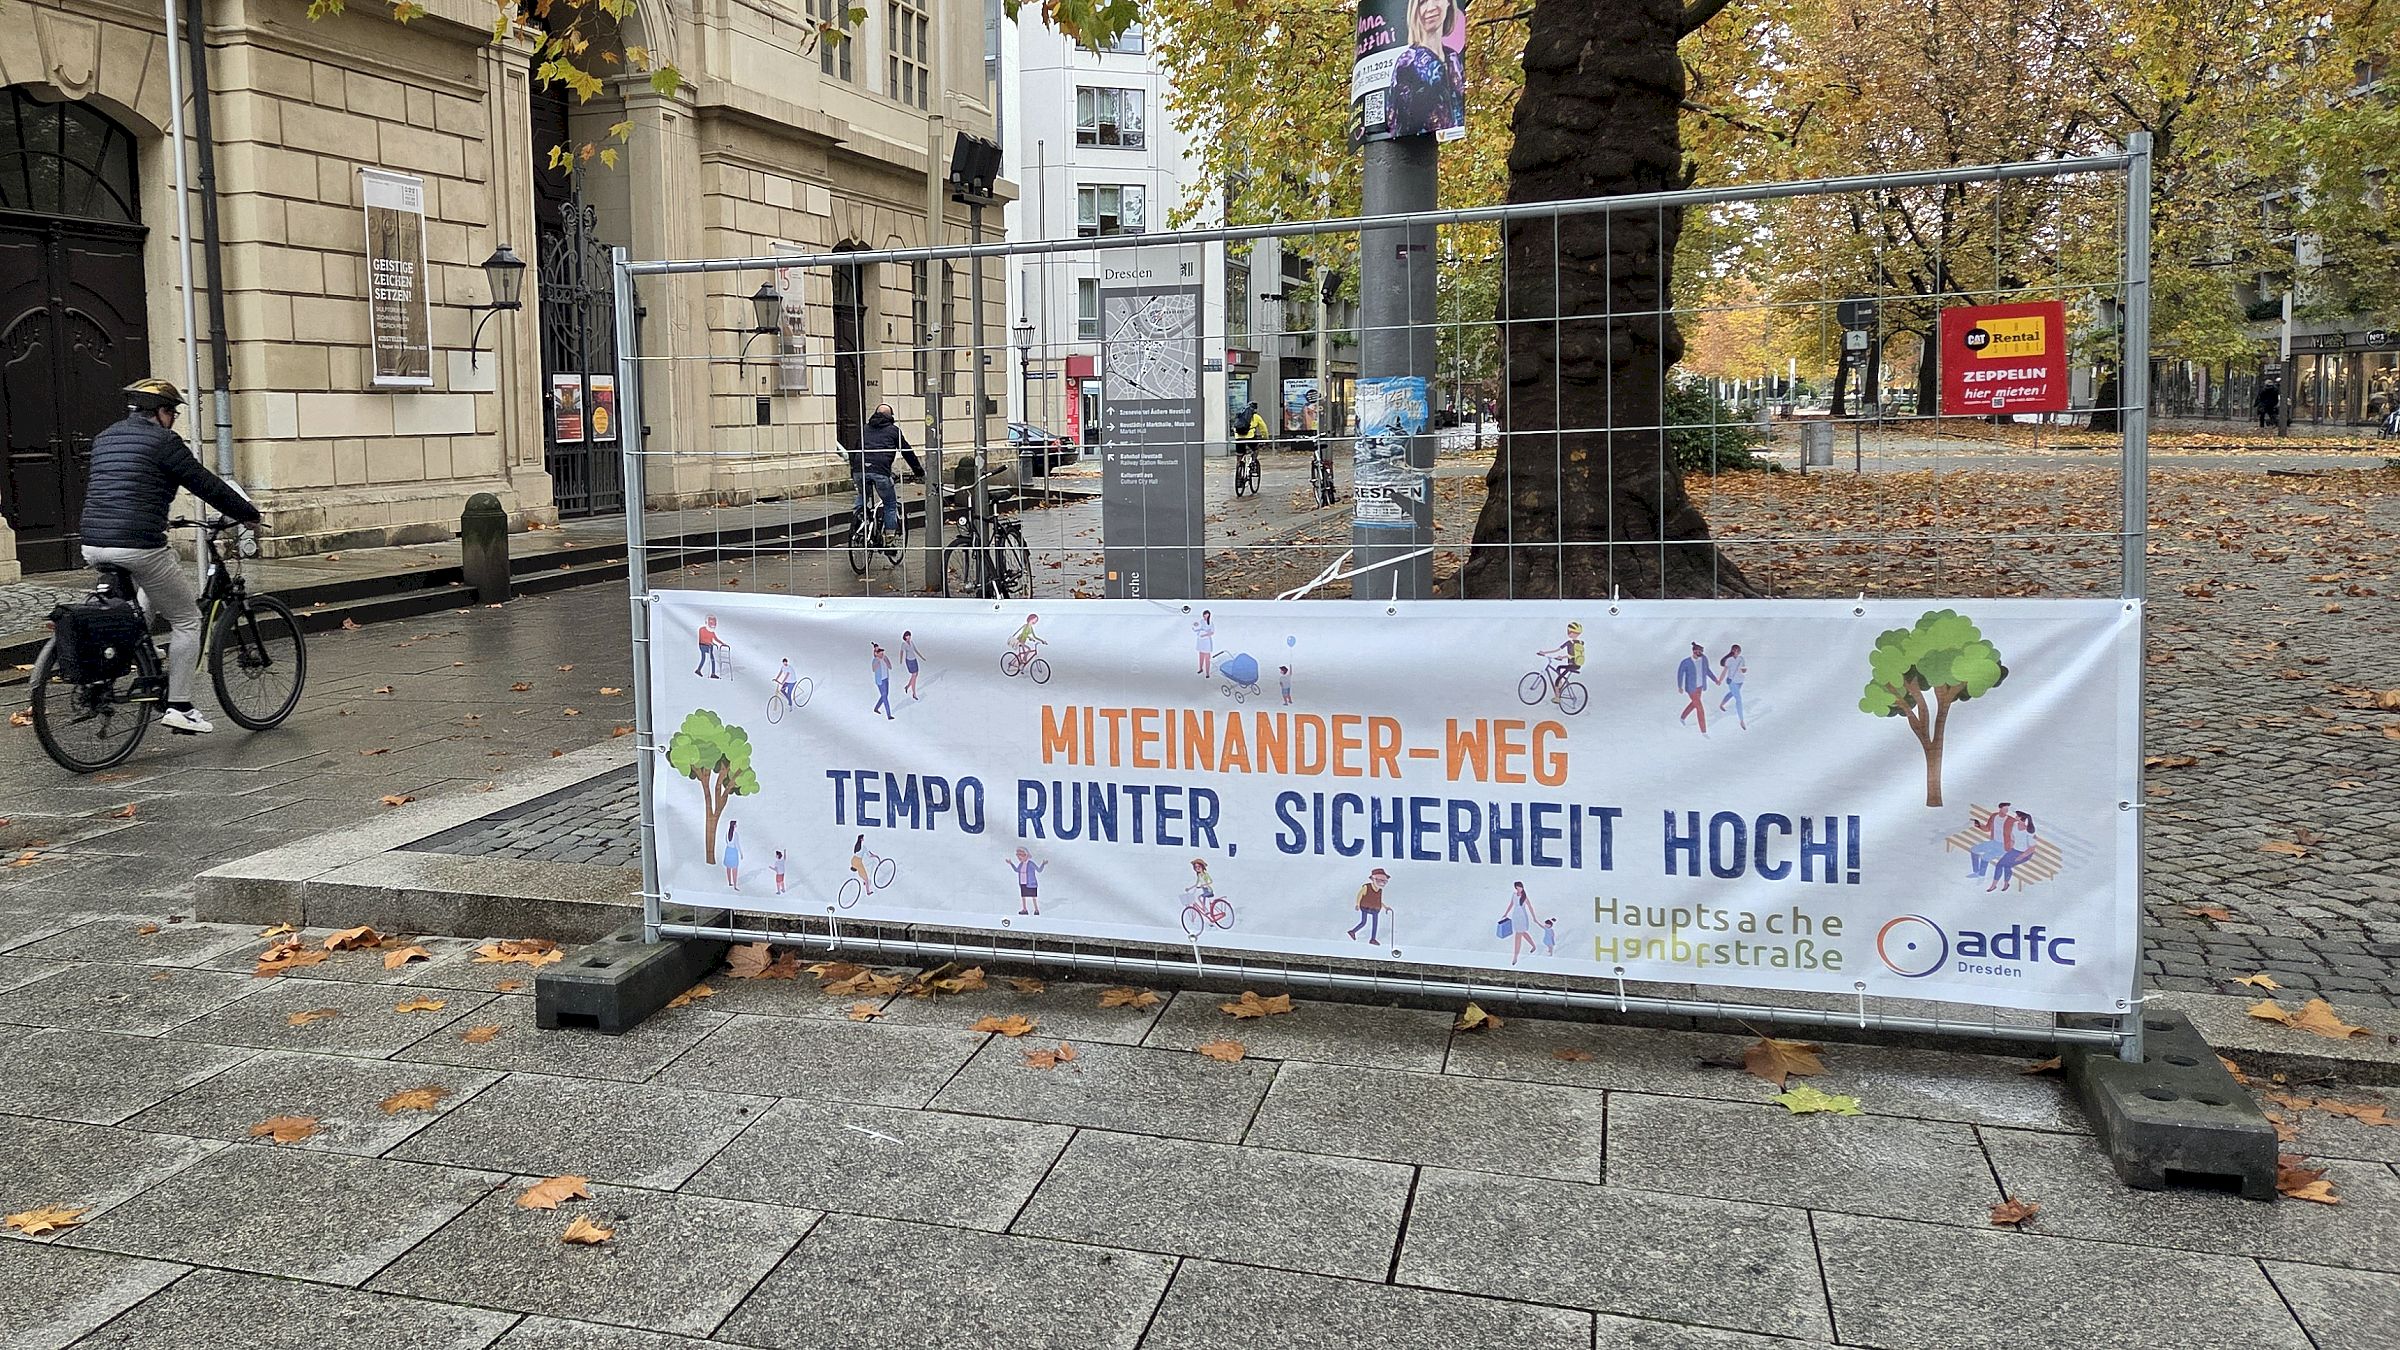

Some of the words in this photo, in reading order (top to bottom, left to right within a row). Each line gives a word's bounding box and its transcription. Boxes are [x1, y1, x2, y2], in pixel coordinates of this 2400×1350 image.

[373, 258, 414, 274] GEISTIGE
[373, 273, 412, 288] ZEICHEN
[1104, 268, 1153, 280] Dresden
[374, 288, 412, 302] SETZEN!
[1967, 334, 1986, 346] CAT
[1992, 331, 2040, 343] Rental
[1963, 368, 2046, 383] ZEPPELIN
[1964, 388, 1991, 399] hier
[1354, 486, 1422, 499] RESDEN
[1128, 571, 1140, 599] rche
[1041, 703, 1570, 787] MITEINANDER-WEG
[826, 768, 986, 836] TEMPO
[1017, 778, 1238, 858] RUNTER,
[1274, 790, 1623, 872] SICHERHEIT
[1662, 808, 1862, 886] HOCH!
[1594, 896, 1844, 938] Hauptsache
[1956, 924, 2076, 967] adfc
[1958, 961, 2022, 978] Dresden
